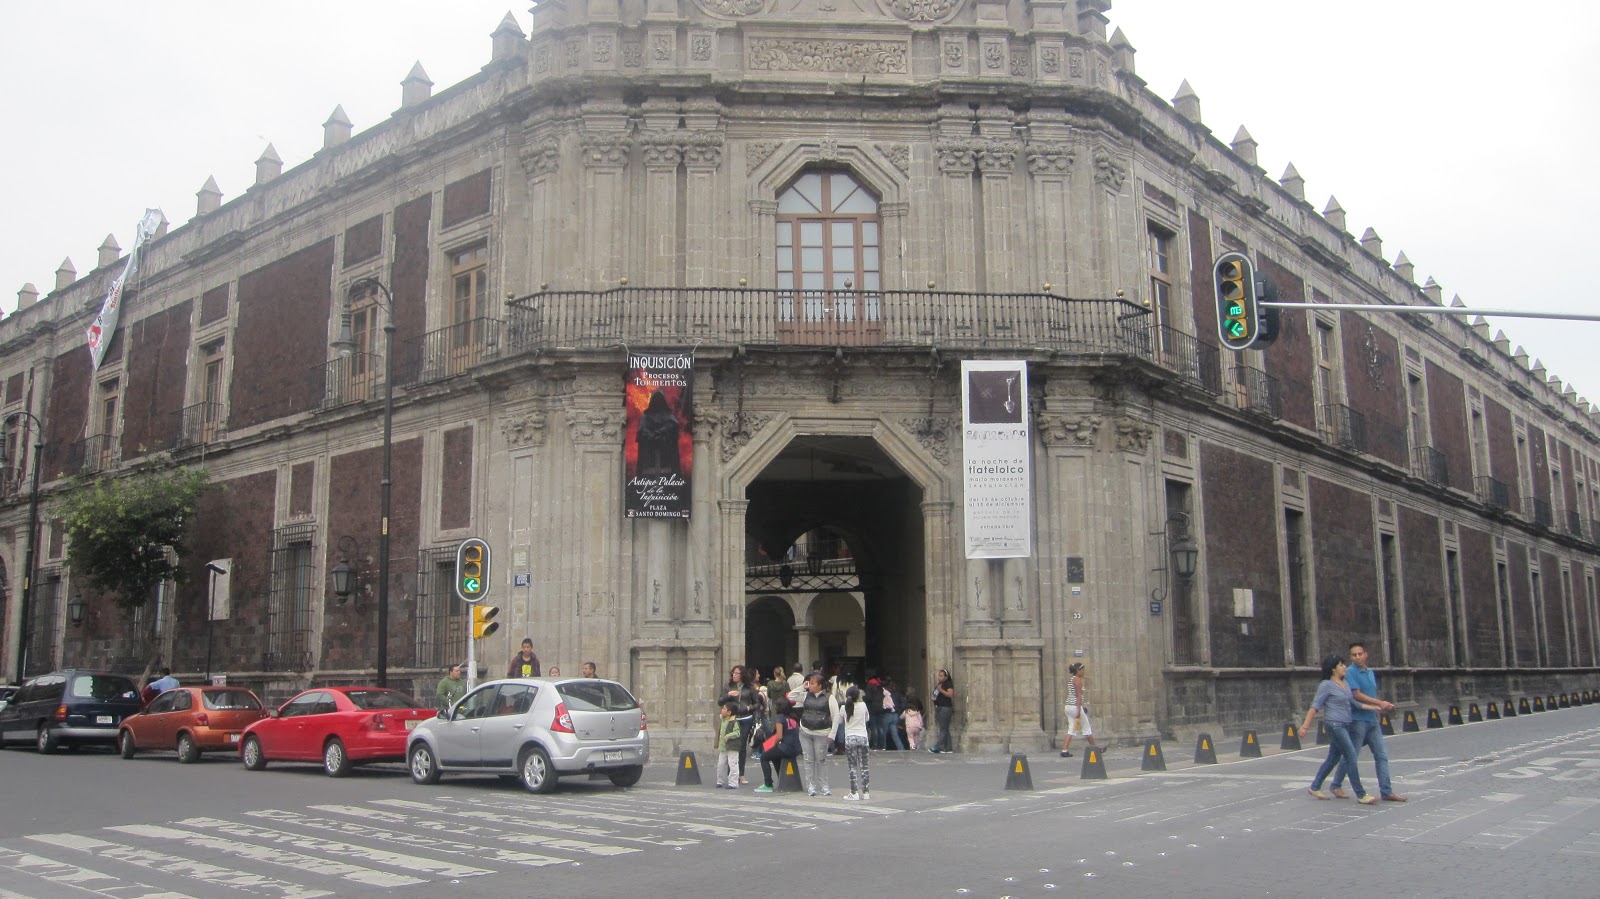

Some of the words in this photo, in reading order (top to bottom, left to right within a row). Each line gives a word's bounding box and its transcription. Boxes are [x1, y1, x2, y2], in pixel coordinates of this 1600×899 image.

[630, 354, 691, 370] INQUISICIÓN
[968, 465, 1024, 474] tlatelolco
[658, 473, 686, 486] Palacio
